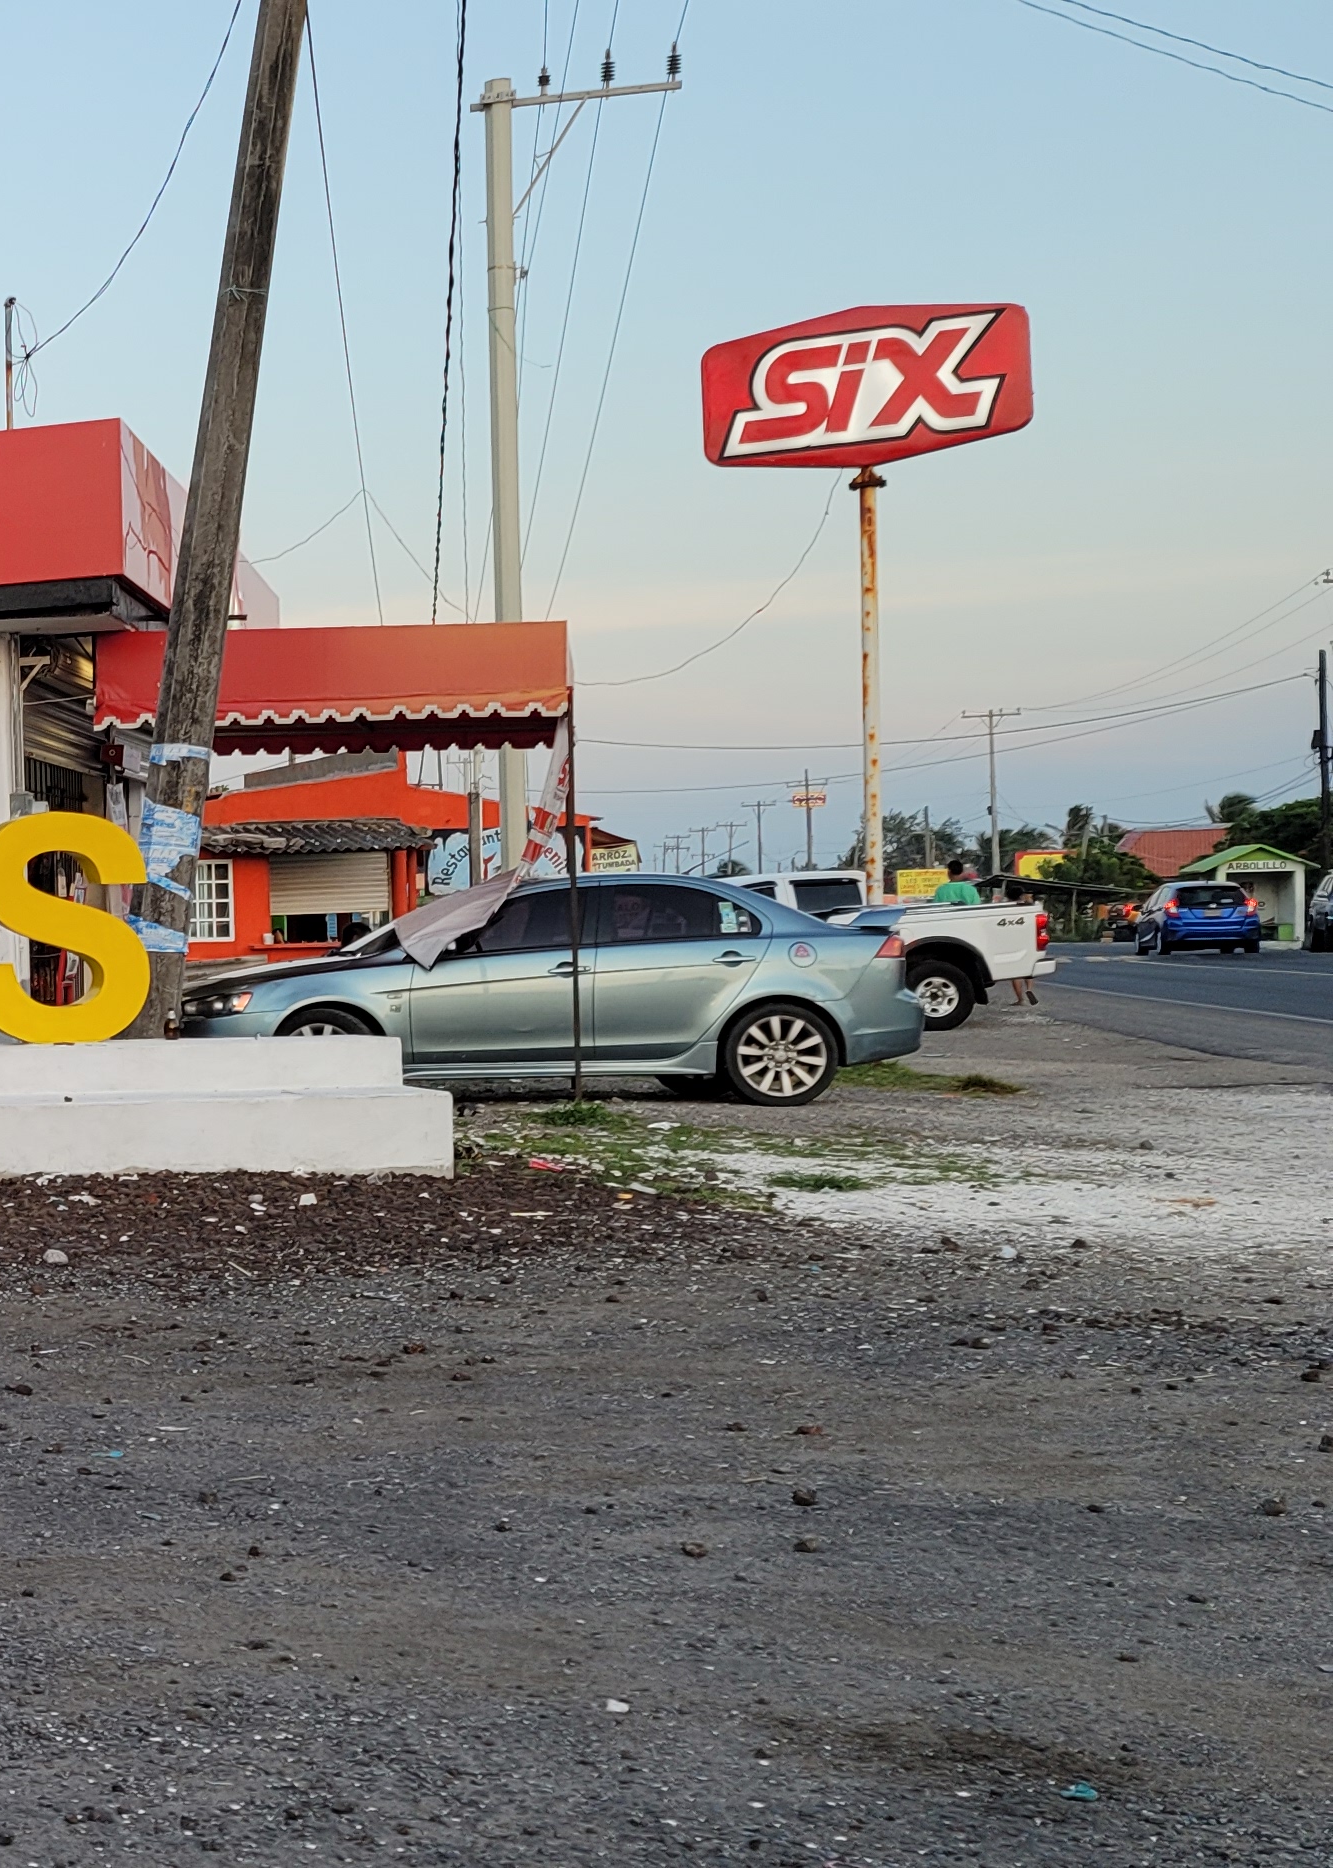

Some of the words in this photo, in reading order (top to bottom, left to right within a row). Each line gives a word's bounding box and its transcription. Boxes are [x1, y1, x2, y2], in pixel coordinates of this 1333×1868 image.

[431, 830, 501, 886] Restant
[592, 850, 627, 861] ARROZ
[597, 859, 636, 869] TUMBADA
[1227, 861, 1286, 870] ARBOLILLO
[997, 917, 1025, 926] 4x4
